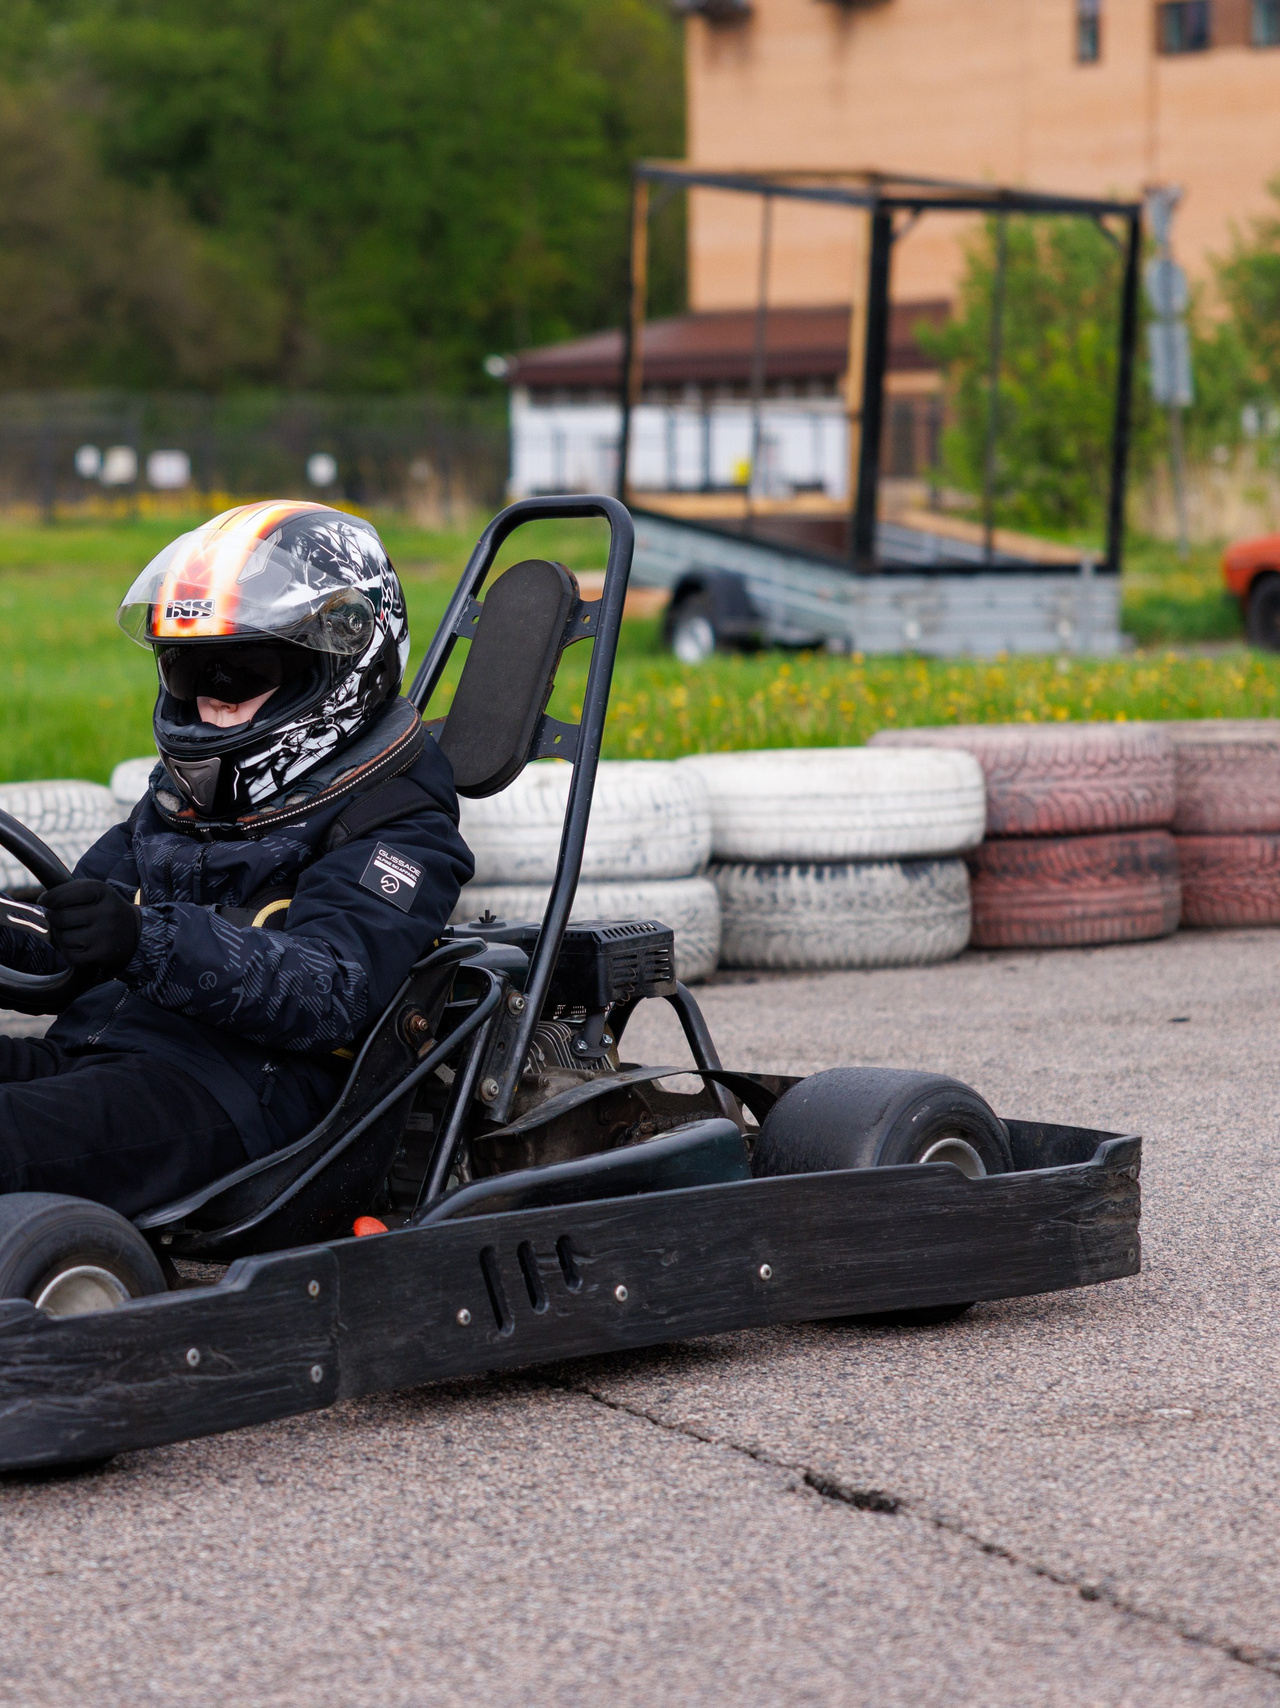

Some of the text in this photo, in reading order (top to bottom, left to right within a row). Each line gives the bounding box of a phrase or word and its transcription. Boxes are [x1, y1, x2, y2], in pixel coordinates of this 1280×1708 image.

[376, 855, 392, 867] ALPINE
[399, 868, 418, 882] APPAREL
[378, 849, 421, 876] GLISSADE
